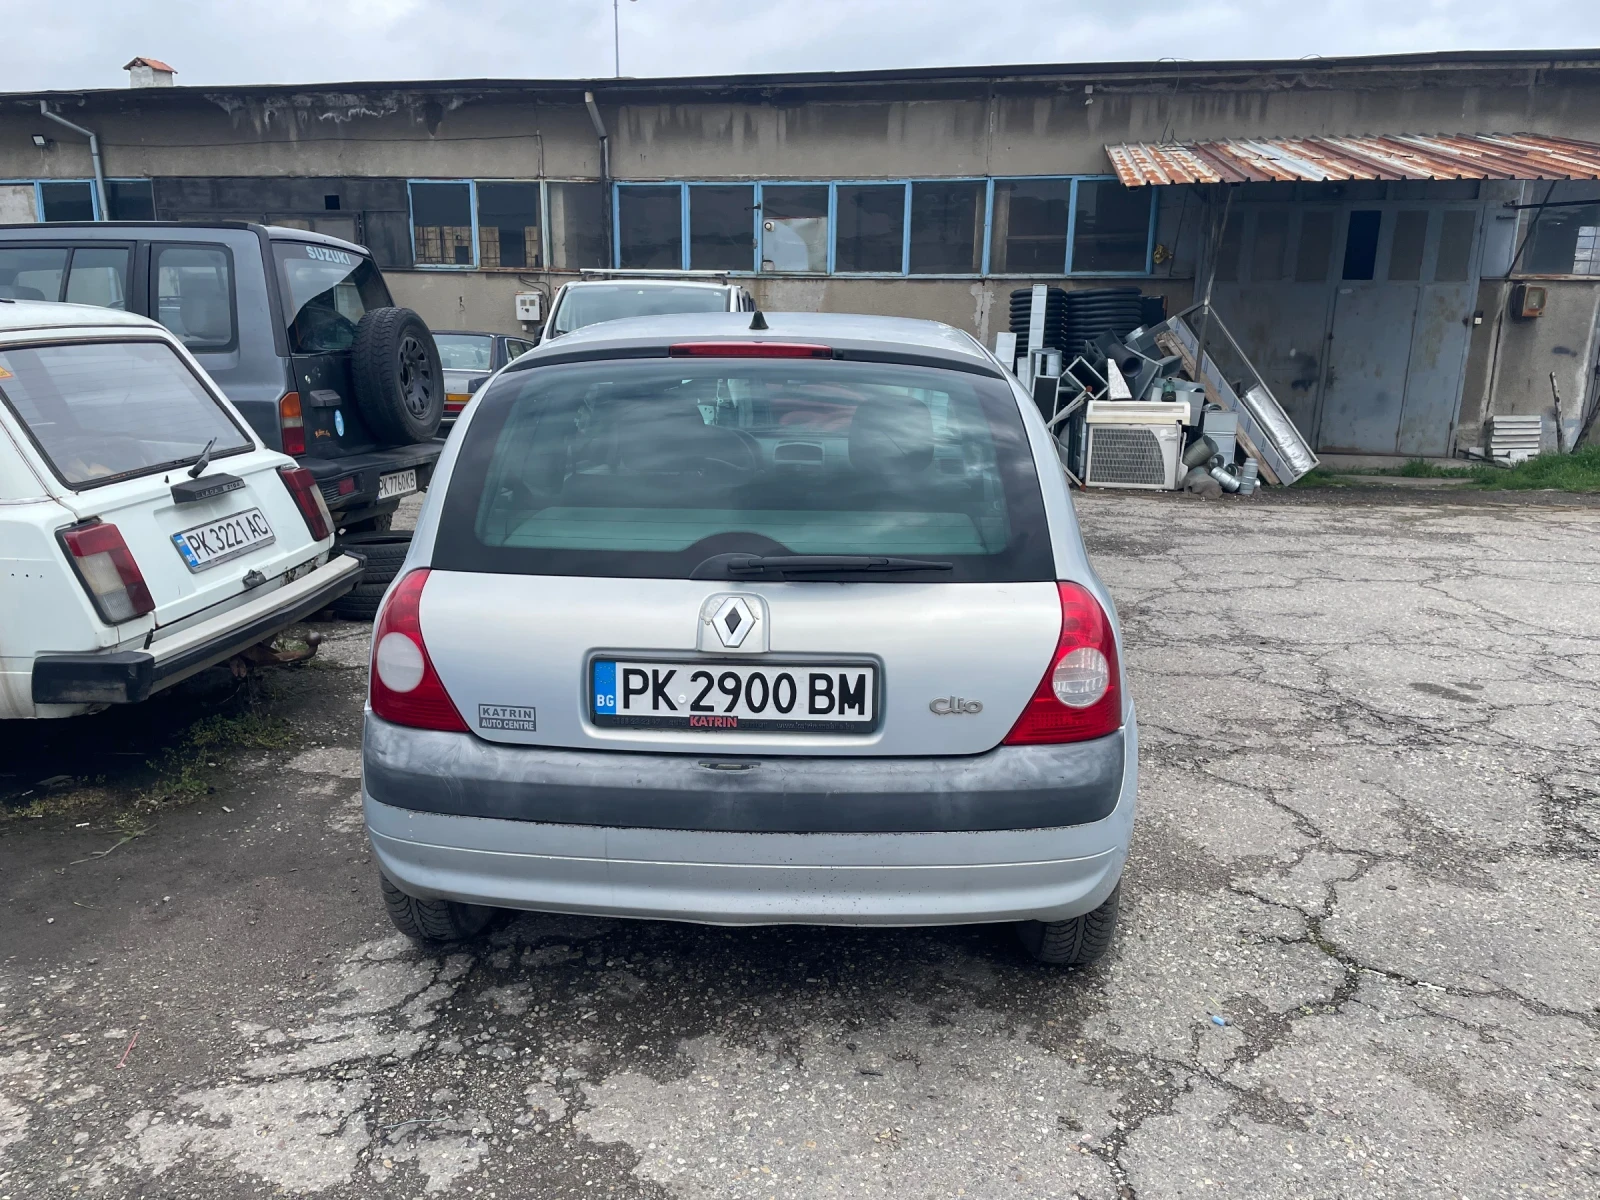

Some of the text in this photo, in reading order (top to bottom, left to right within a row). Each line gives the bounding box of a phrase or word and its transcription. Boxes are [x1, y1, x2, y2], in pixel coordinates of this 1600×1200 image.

[305, 245, 351, 265] SUZUKI
[186, 513, 269, 559] PK 3221 AC
[622, 667, 866, 716] PK 2900 BM
[597, 694, 614, 707] BG
[929, 695, 984, 715] Clio
[482, 707, 532, 719] KATRIN
[481, 719, 534, 730] AUTO CENTRE
[690, 715, 738, 728] KATRIN
